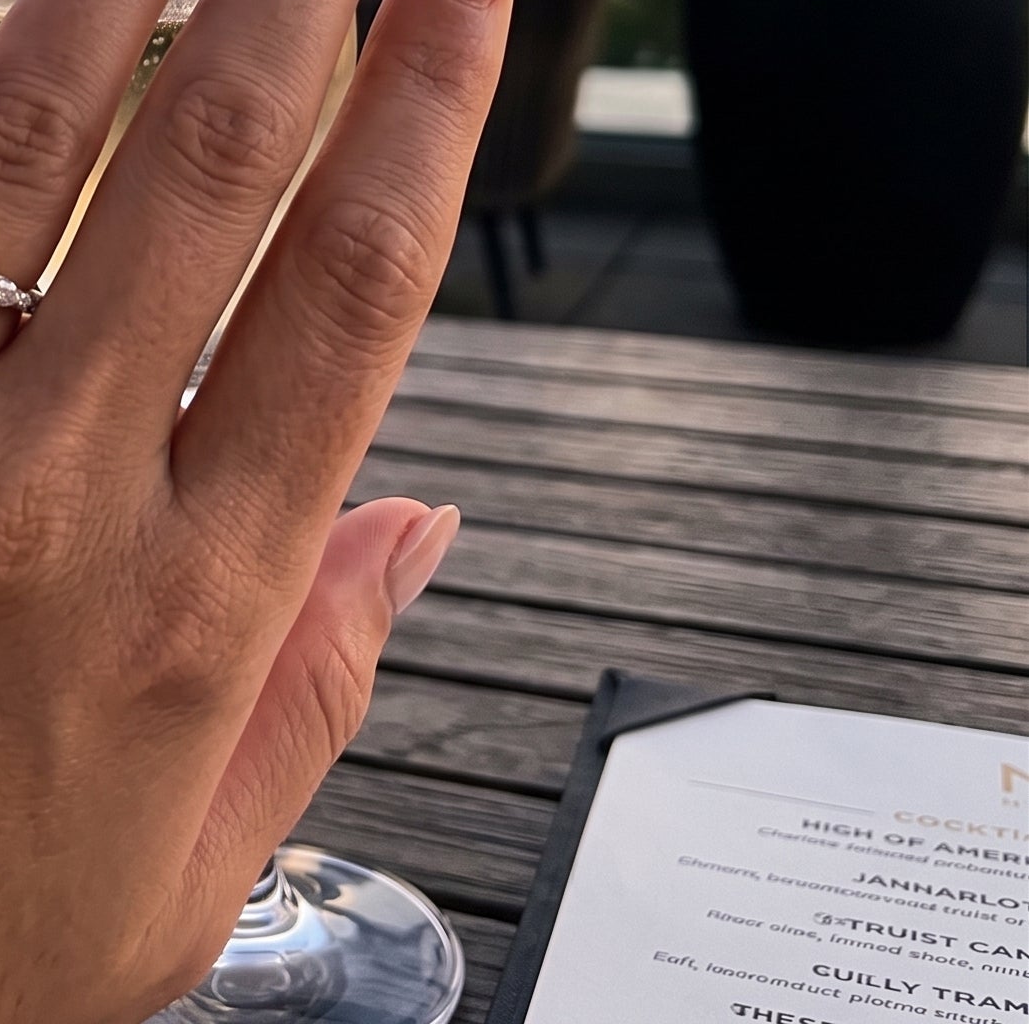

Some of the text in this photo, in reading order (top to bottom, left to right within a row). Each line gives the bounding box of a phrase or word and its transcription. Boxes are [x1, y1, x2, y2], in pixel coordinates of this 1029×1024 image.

[801, 819, 873, 840] HIGH
[883, 833, 925, 848] OF
[932, 986, 1029, 1016] TRAM
